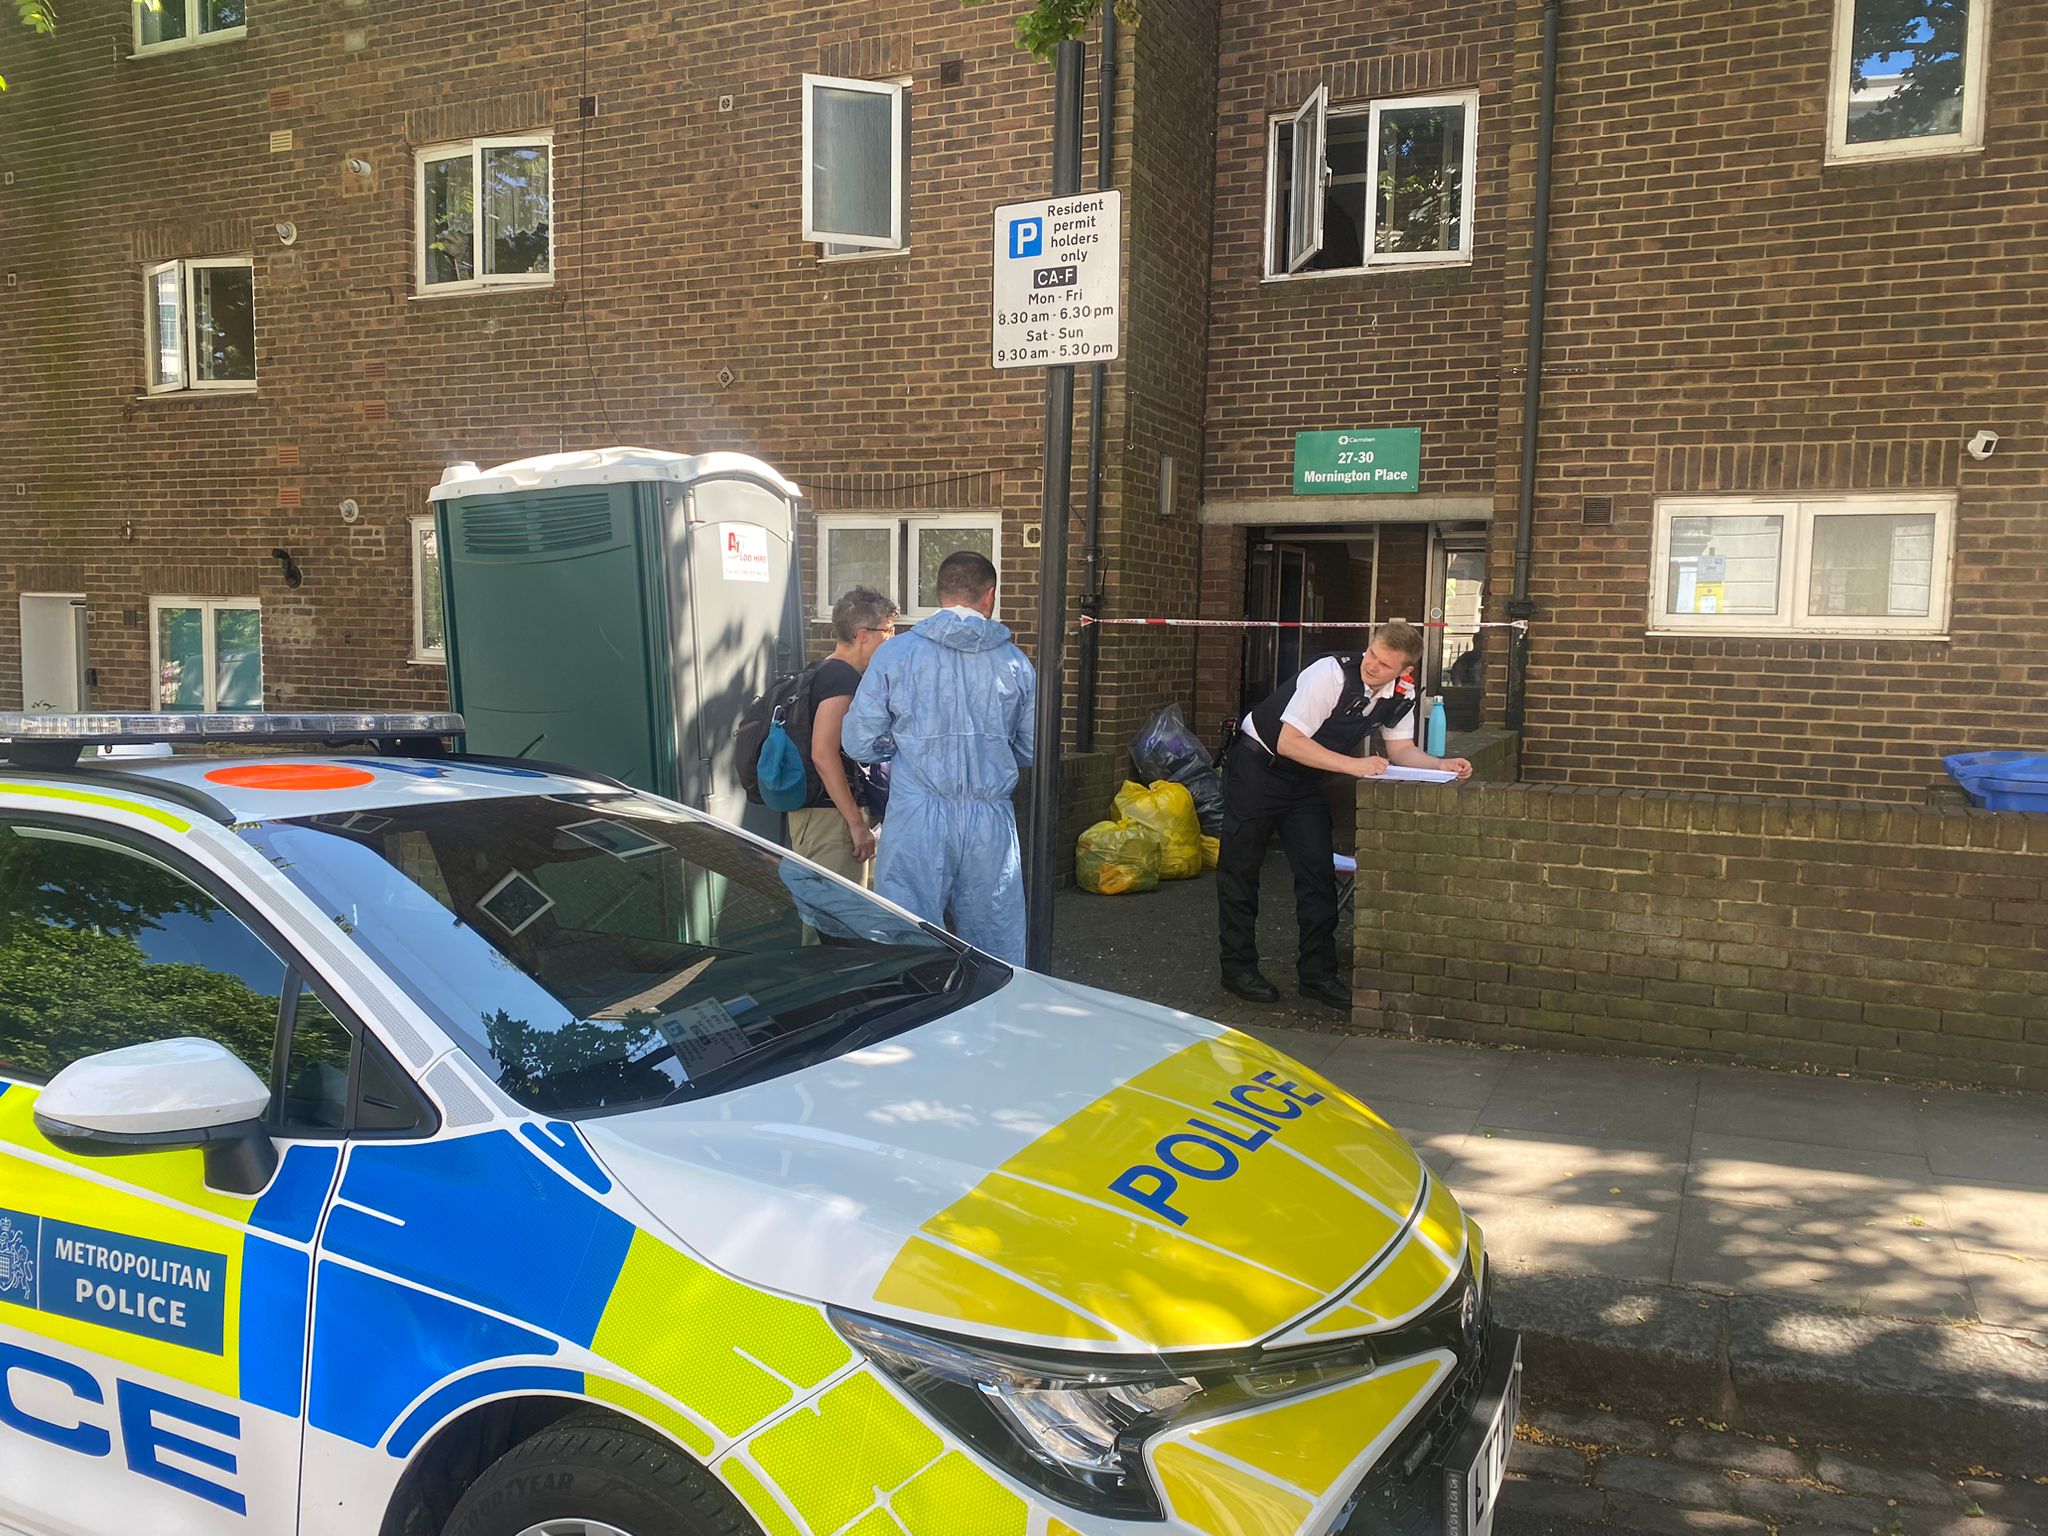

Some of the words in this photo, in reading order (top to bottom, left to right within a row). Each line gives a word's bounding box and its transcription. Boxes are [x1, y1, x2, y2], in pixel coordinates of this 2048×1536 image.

[1047, 199, 1104, 217] Resident
[1053, 216, 1096, 234] permit
[1017, 222, 1038, 255] P
[1050, 233, 1099, 248] holders
[1060, 249, 1089, 263] only
[1037, 268, 1074, 286] CA-F
[1028, 293, 1055, 305] Mon
[1066, 289, 1083, 302] Fri
[998, 312, 1028, 325] 8.30
[1031, 314, 1049, 323] am
[1060, 305, 1091, 320] 6.30
[1093, 306, 1114, 319] pm
[1026, 330, 1048, 342] Sat
[1058, 327, 1084, 339] Sun
[997, 349, 1028, 362] 9.30
[1030, 350, 1049, 359] am
[1059, 342, 1090, 357] 5.30
[1093, 343, 1113, 356] pm
[1337, 451, 1374, 464] 27-30
[1304, 470, 1371, 483] Mornington
[1374, 468, 1408, 481] Place
[1107, 1070, 1326, 1227] POLICE
[55, 1237, 211, 1292] METROPOLITAN
[75, 1278, 187, 1328] POLICE
